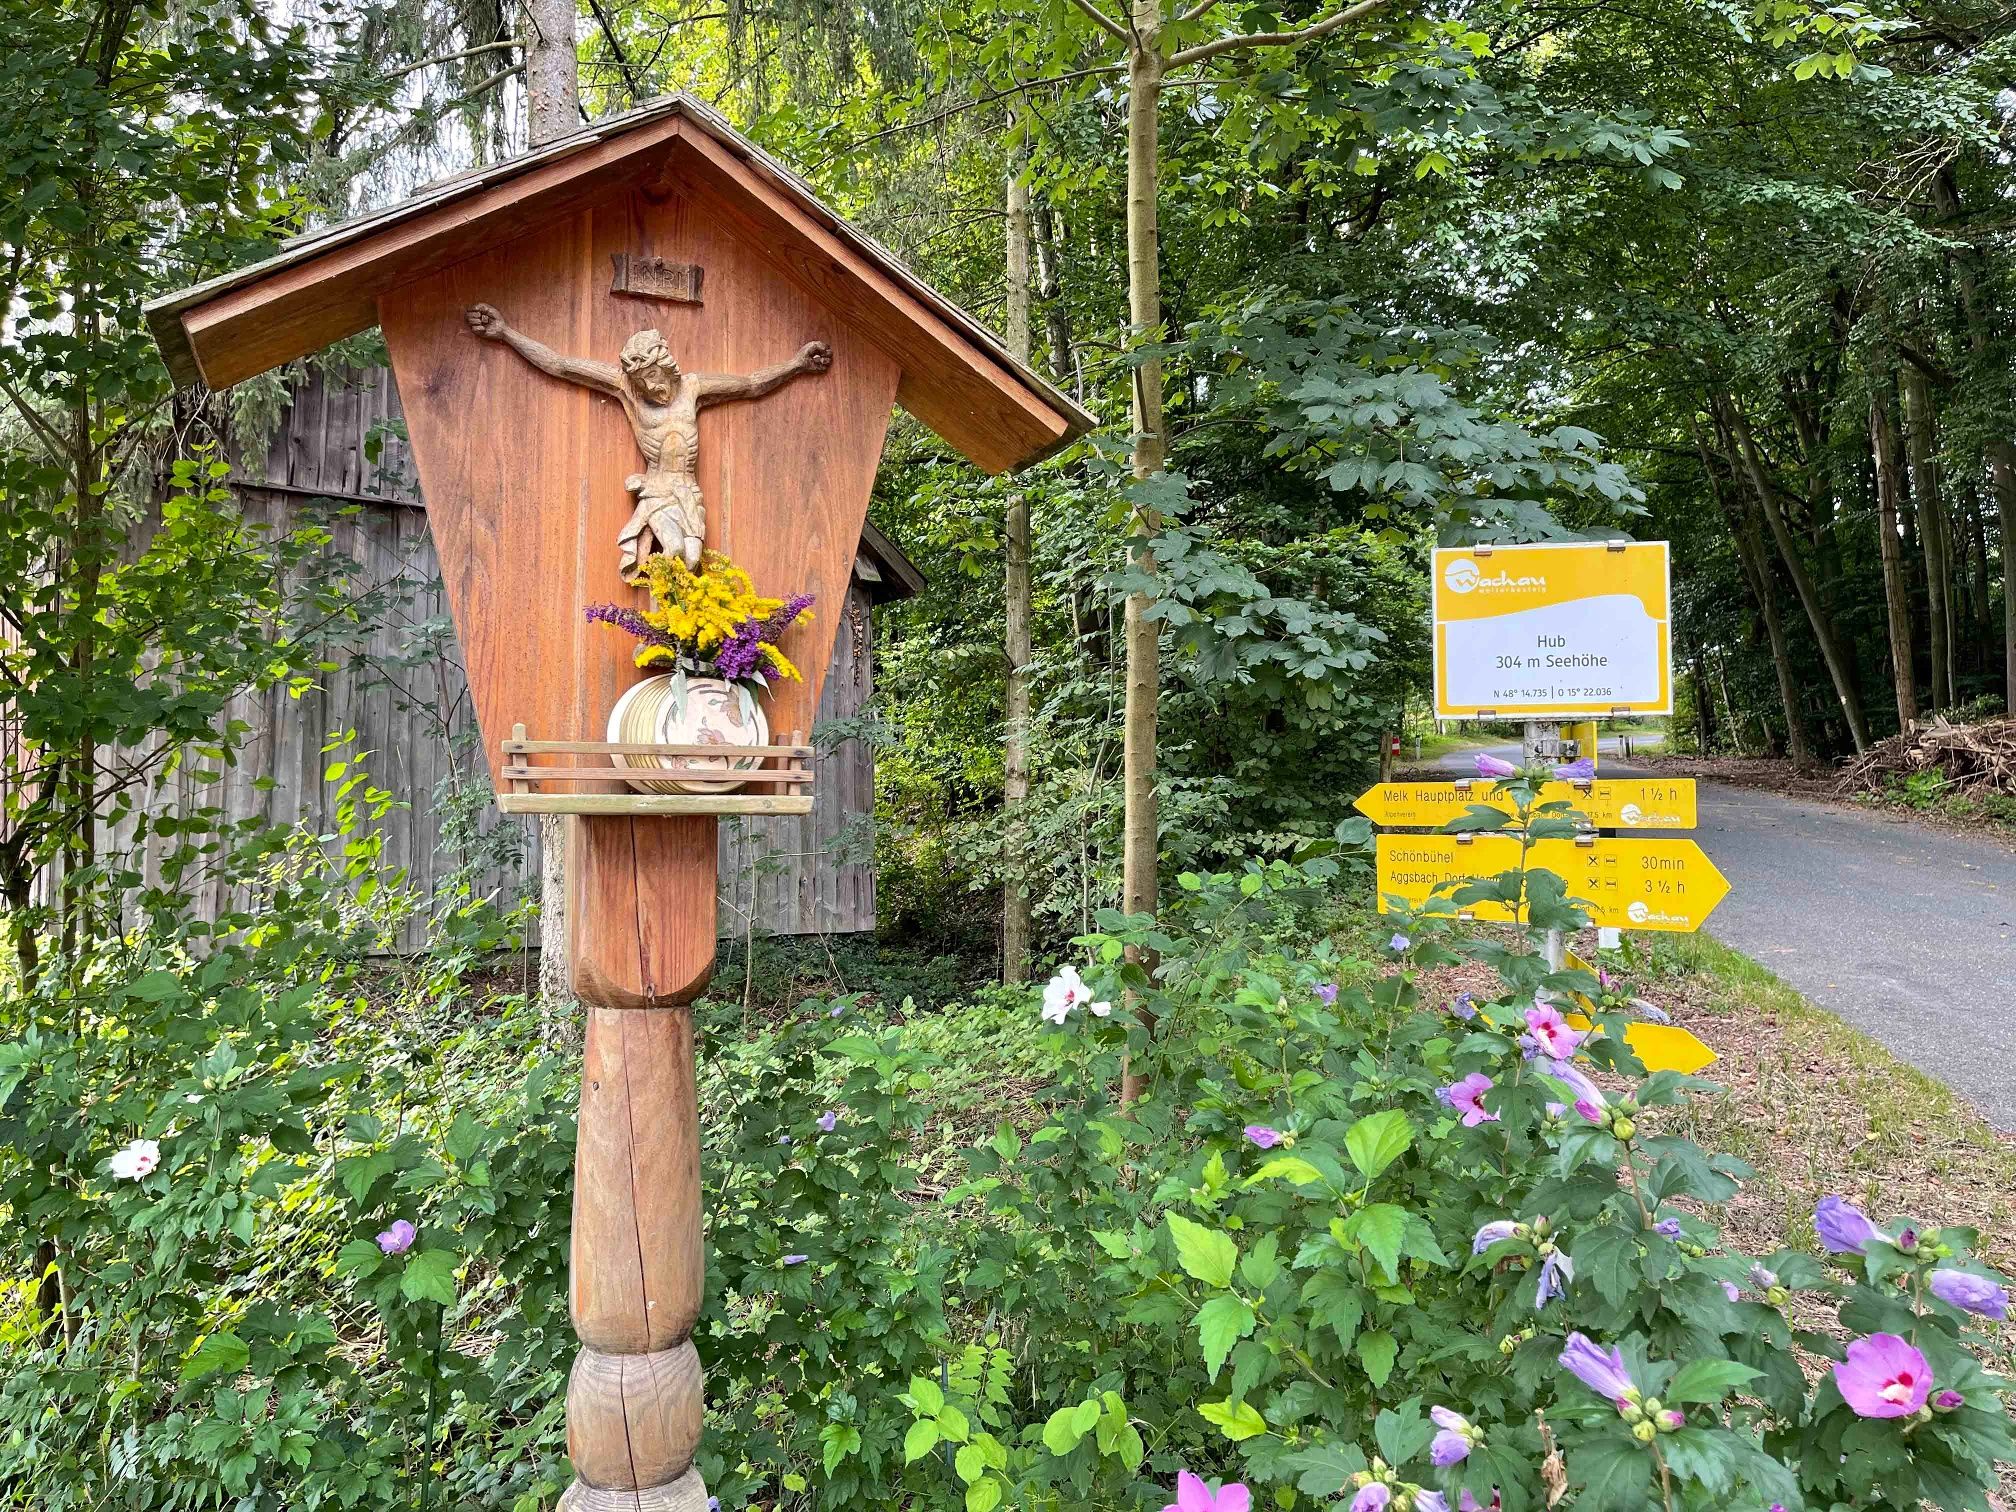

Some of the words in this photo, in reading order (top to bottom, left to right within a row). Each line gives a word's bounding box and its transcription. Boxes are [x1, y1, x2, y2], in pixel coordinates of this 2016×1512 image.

[633, 264, 683, 290] INRI
[1446, 564, 1546, 592] Wachau
[1537, 634, 1566, 648] Hub
[1495, 655, 1522, 669] 304
[1527, 657, 1540, 668] m
[1545, 653, 1608, 668] Seehöhe
[1493, 690, 1500, 698] N
[1502, 689, 1518, 698] 48°
[1520, 688, 1548, 699] 14.735
[1583, 687, 1612, 697] 22.036
[1383, 789, 1409, 802] Melk
[1415, 788, 1474, 805] Hauptplatz
[1669, 787, 1677, 801] h
[1389, 847, 1454, 864] Schönbühel
[1390, 869, 1438, 885] Aggsbach
[1645, 879, 1653, 893] 3
[1677, 880, 1685, 894] h
